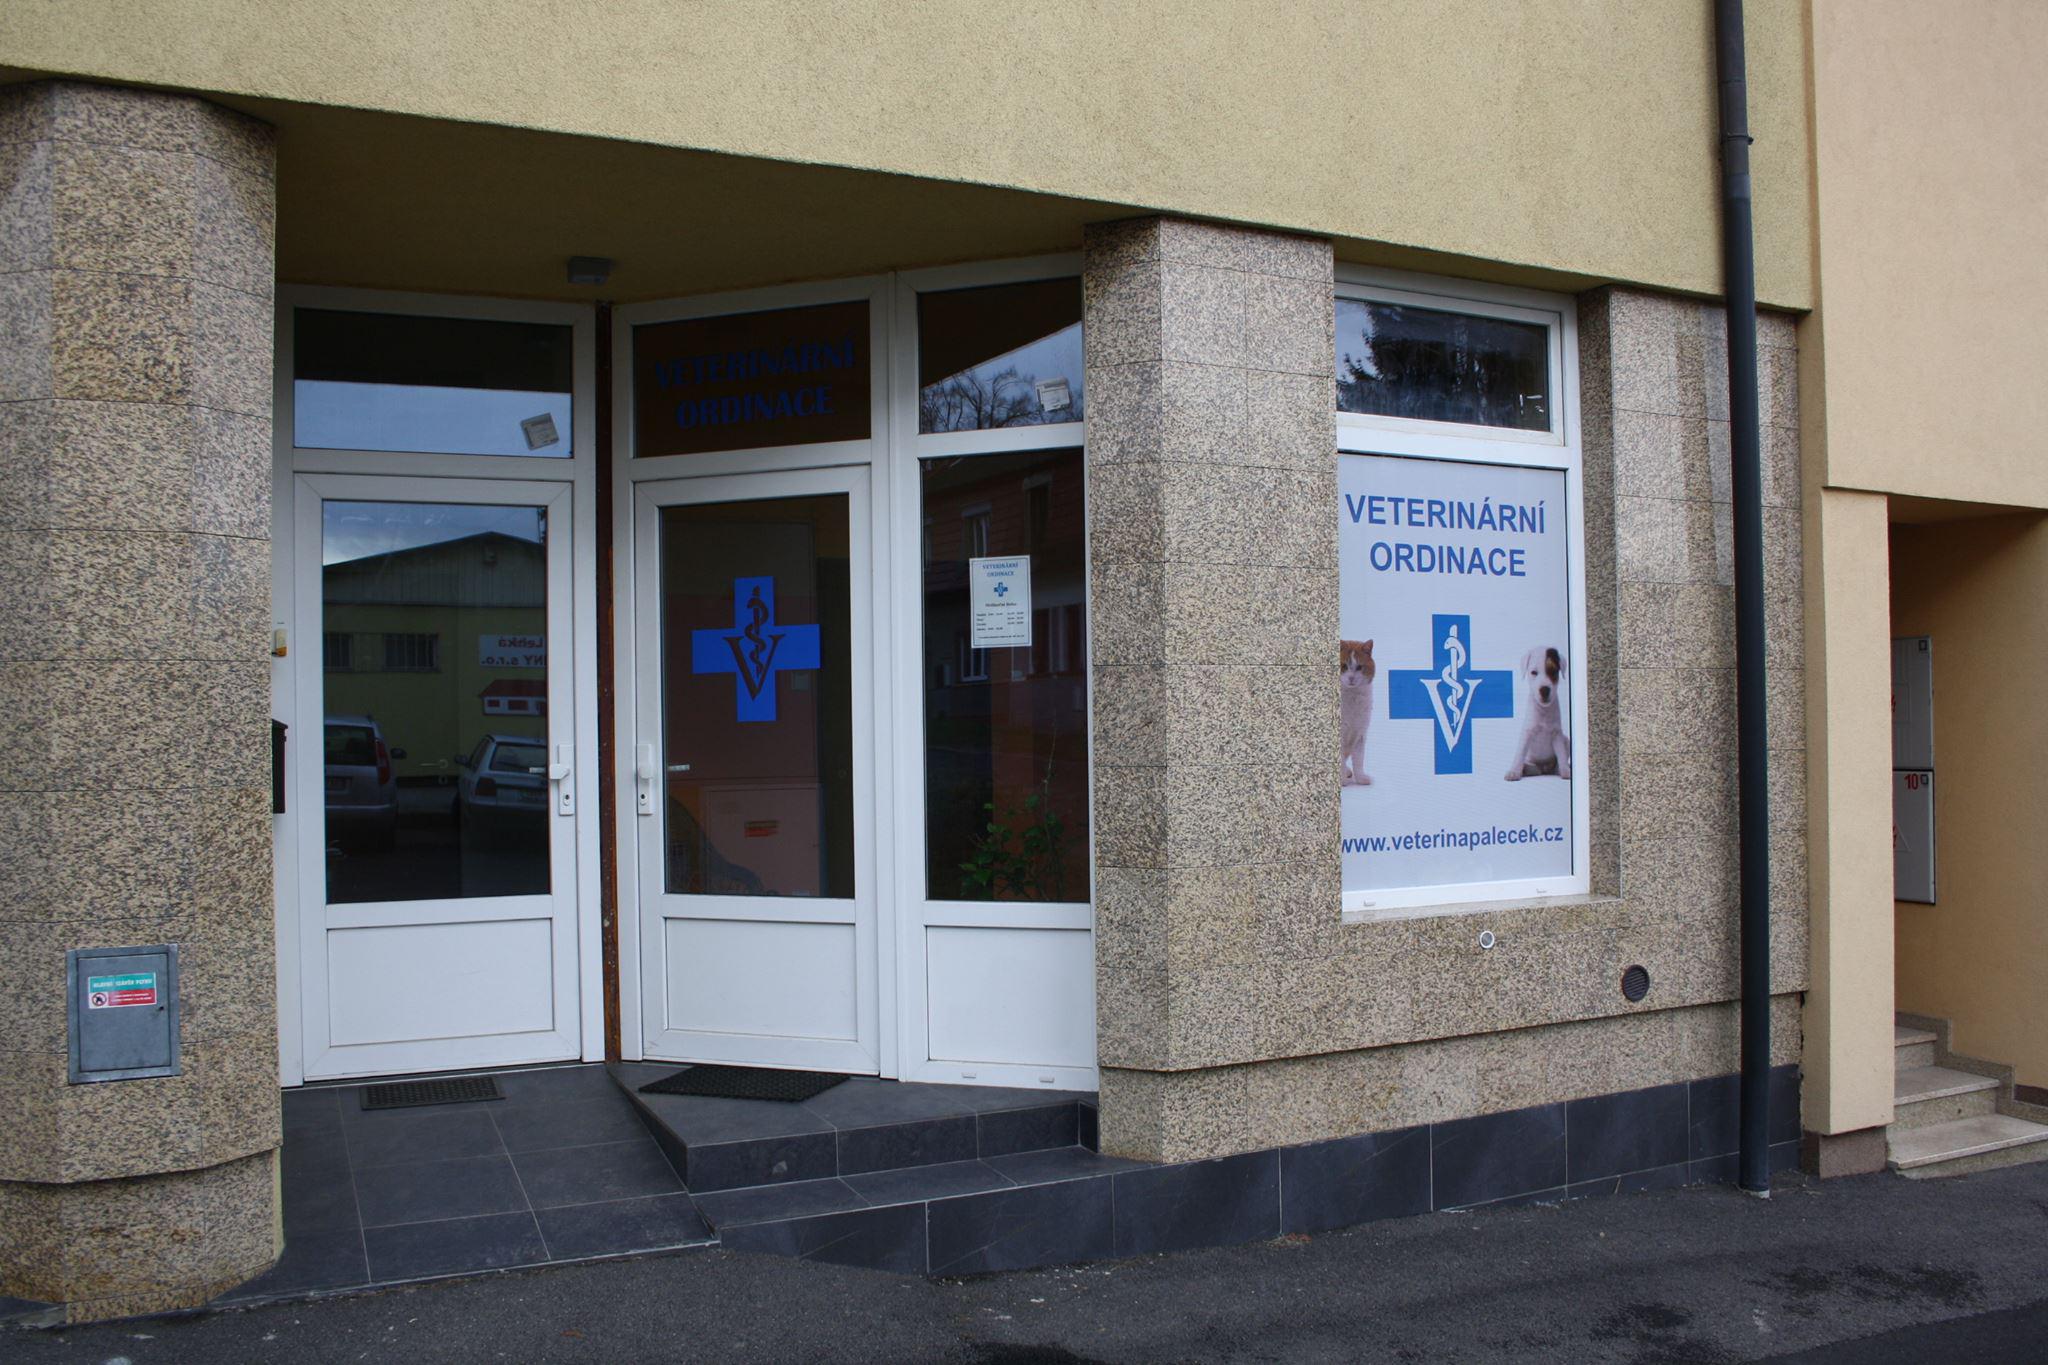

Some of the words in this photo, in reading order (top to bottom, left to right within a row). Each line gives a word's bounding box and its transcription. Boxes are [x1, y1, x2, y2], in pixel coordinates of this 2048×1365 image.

[675, 385, 834, 429] ORDINACE
[1345, 494, 1545, 534] VETERINÁRNÍ
[1370, 542, 1526, 577] ORDINACE
[1904, 773, 1919, 790] 10
[1341, 825, 1562, 854] www.veterinapalecek.cz
